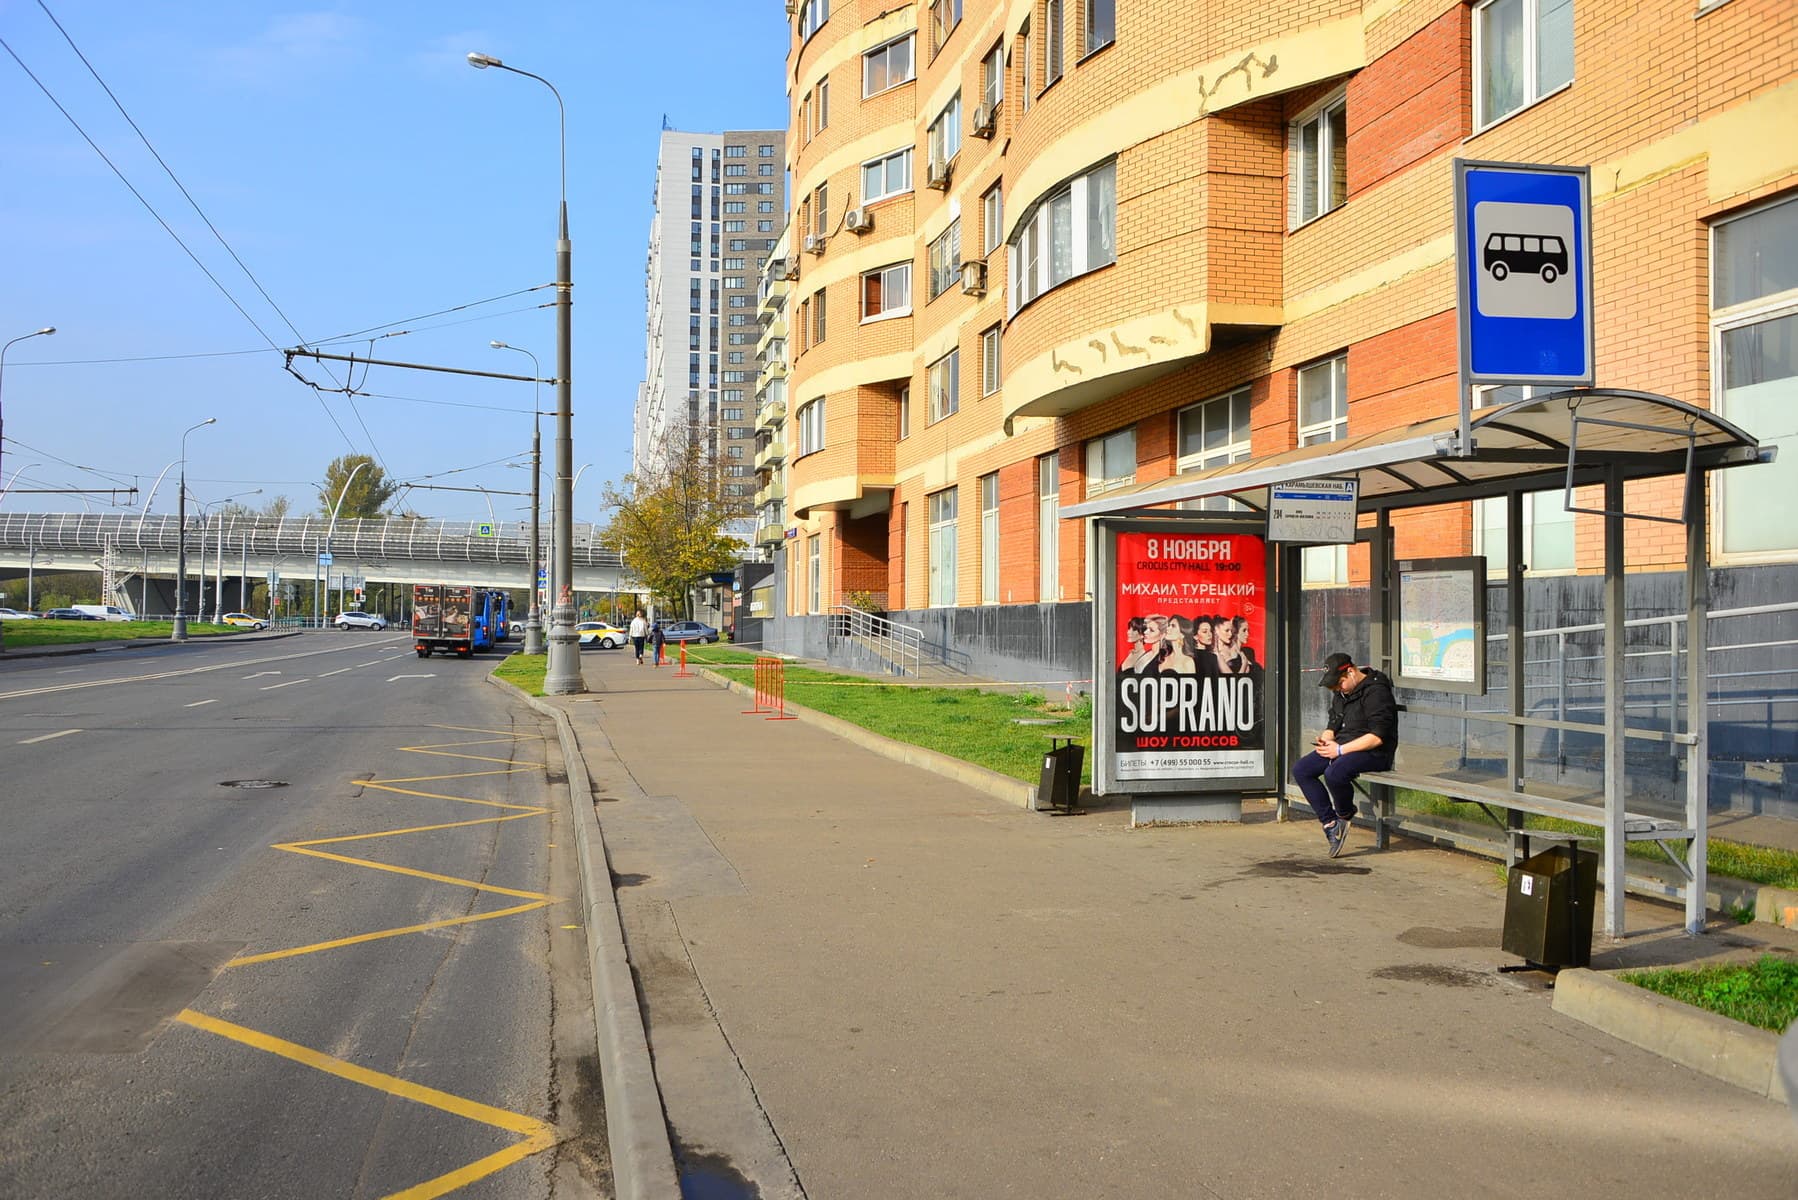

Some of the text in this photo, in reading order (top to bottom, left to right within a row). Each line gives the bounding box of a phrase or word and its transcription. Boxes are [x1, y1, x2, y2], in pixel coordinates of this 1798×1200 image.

[1147, 539, 1231, 560] 8 НОЯБРЯ
[1136, 561, 1241, 571] CROCUS CITY HALL 19:00
[1121, 582, 1255, 597] МИХАИЛ ТУРЕЦКИЙ
[1121, 677, 1255, 733] SOPRANO
[1136, 735, 1239, 748] ШОУ ГОЛОСОВ
[1120, 759, 1147, 767] БИЛЕТЫ
[1160, 758, 1178, 767] (499)
